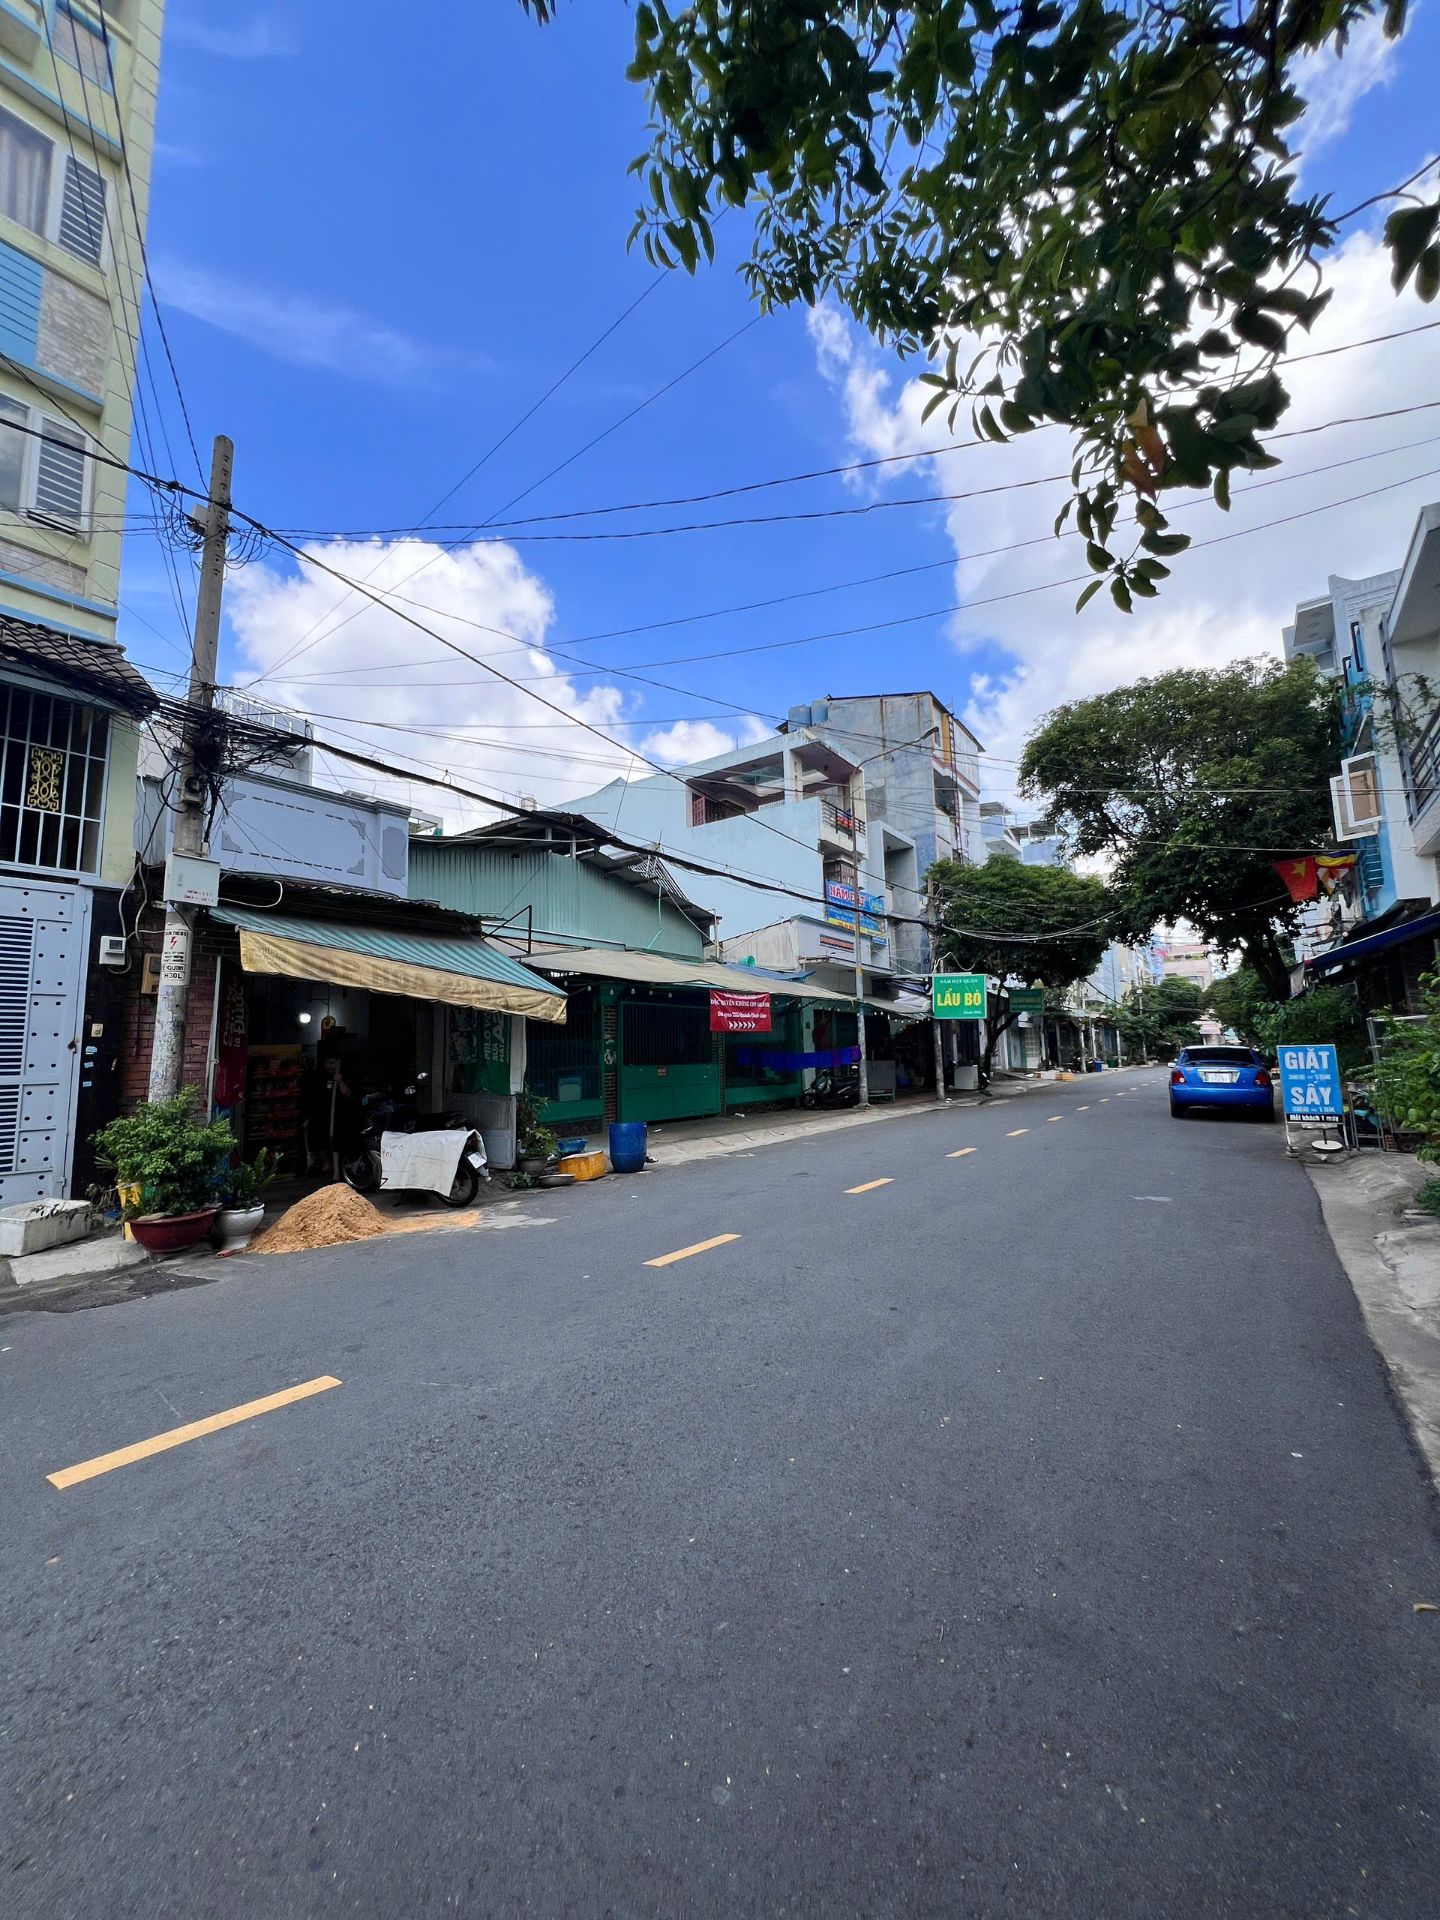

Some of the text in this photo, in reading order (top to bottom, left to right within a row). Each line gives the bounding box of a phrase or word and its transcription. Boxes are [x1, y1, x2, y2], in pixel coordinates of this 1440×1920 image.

[965, 989, 981, 1006] BÒ
[1284, 1048, 1330, 1073] GIẶT
[1290, 1081, 1331, 1105] SẤY
